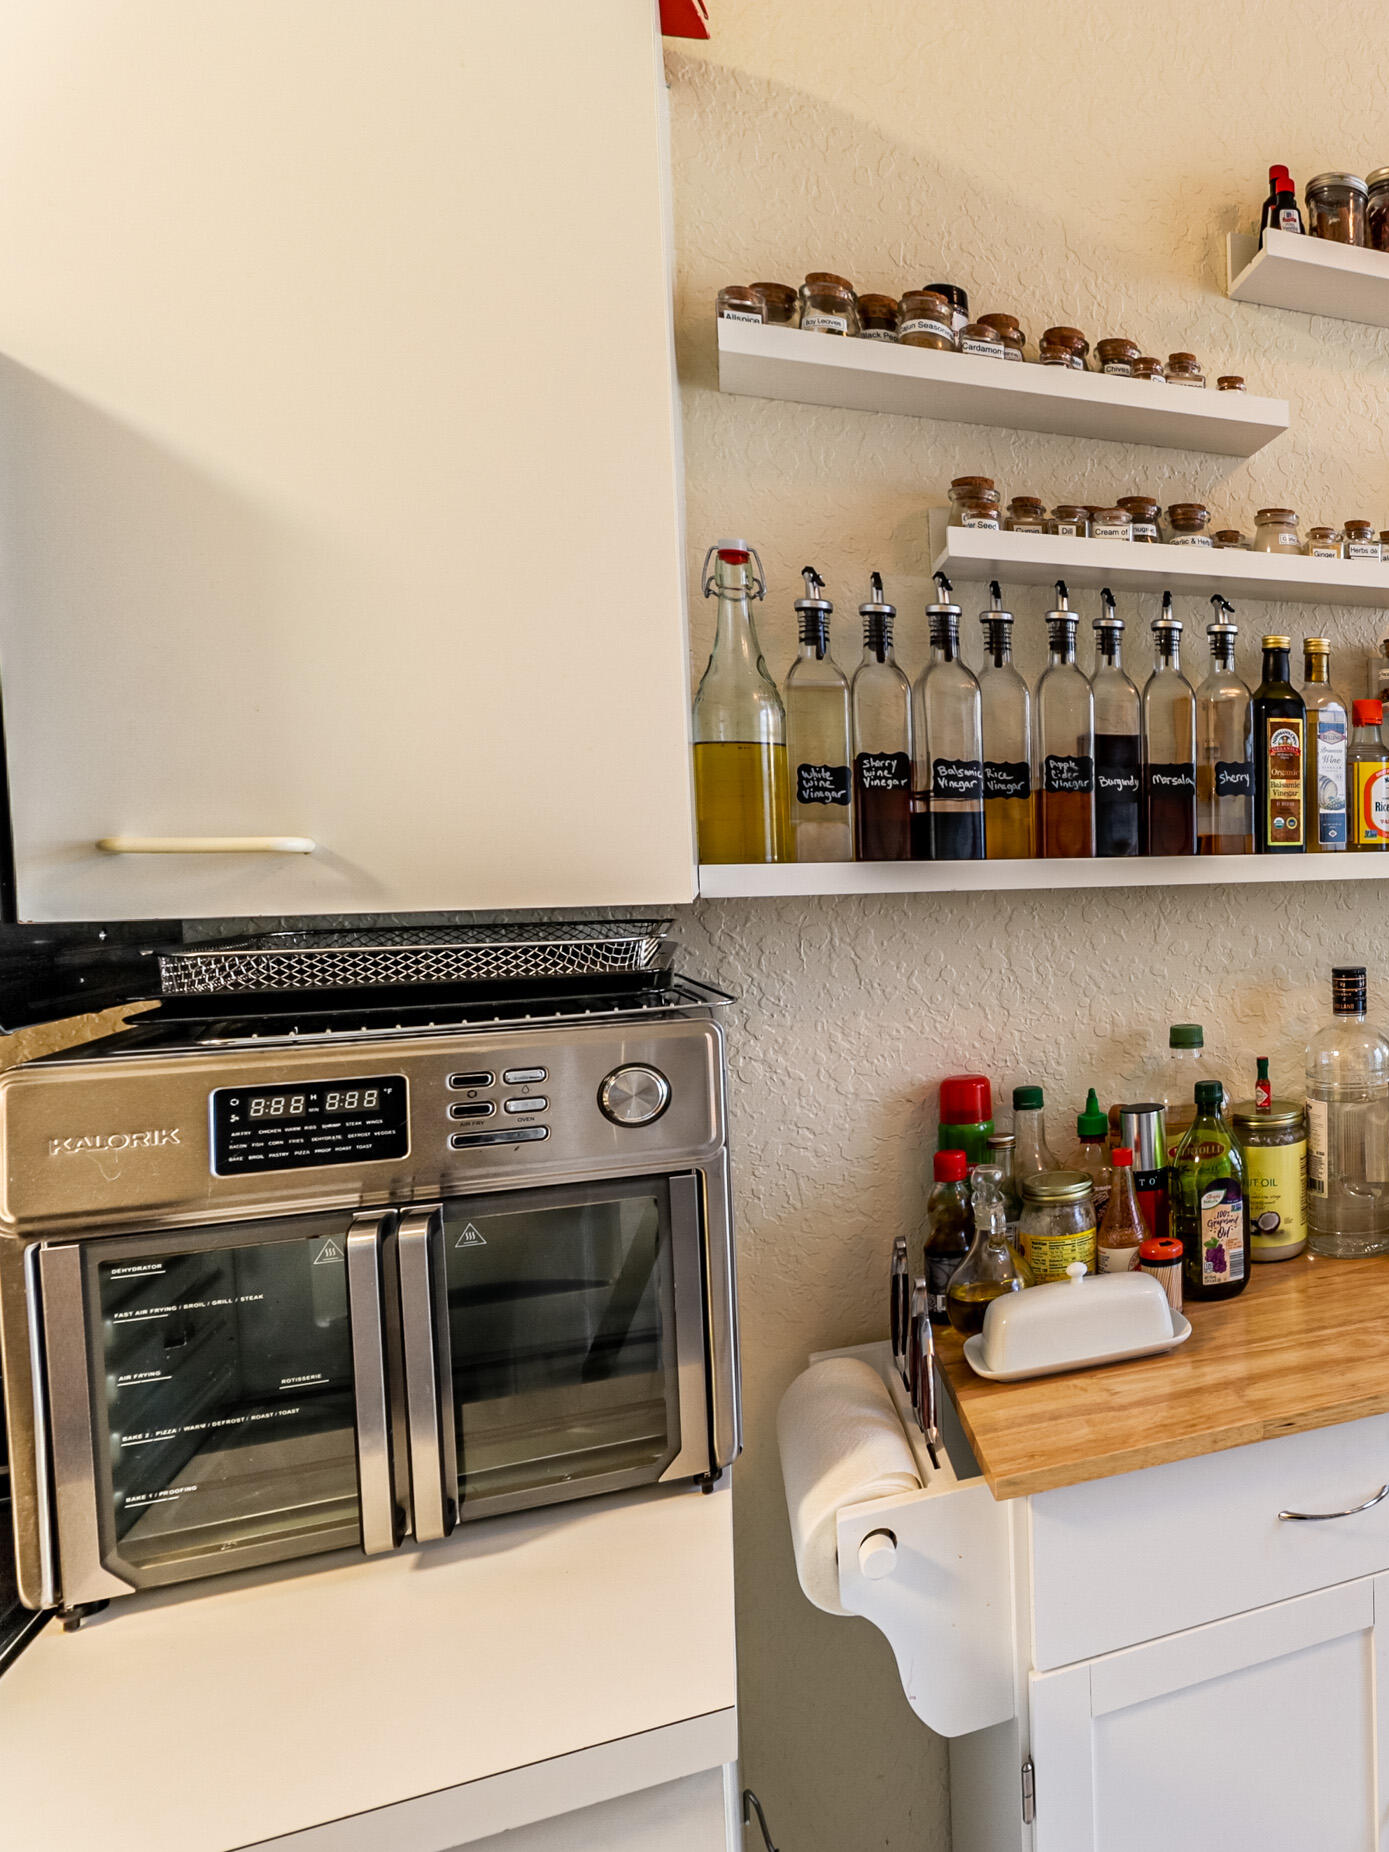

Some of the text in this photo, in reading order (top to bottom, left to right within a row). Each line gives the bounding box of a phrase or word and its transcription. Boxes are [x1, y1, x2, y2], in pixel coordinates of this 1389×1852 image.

[1061, 527, 1074, 536] Dill
[1094, 528, 1119, 536] Cream
[984, 768, 1014, 780] Rice
[1271, 768, 1299, 778] Organic
[1270, 781, 1301, 789] Balsamic
[1272, 789, 1299, 798] Vinegar
[48, 1128, 181, 1156] KALORIK
[1260, 1178, 1278, 1188] OIL
[111, 1263, 163, 1275] DEHYDRATOR
[114, 1311, 134, 1319] FAST
[150, 1305, 178, 1314] FRYING
[212, 1298, 233, 1306] GRILL
[118, 1370, 162, 1382] AIR FRYING
[281, 1373, 323, 1384] ROTISSERIE
[122, 1433, 143, 1442] BAKE
[156, 1428, 177, 1436] PIZZA
[184, 1423, 207, 1432] WARM
[212, 1417, 245, 1427] DEFROST
[251, 1413, 274, 1421] ROAST
[279, 1408, 300, 1416] TOAST
[126, 1494, 147, 1503] BAKE
[159, 1485, 198, 1497] PROOFING
